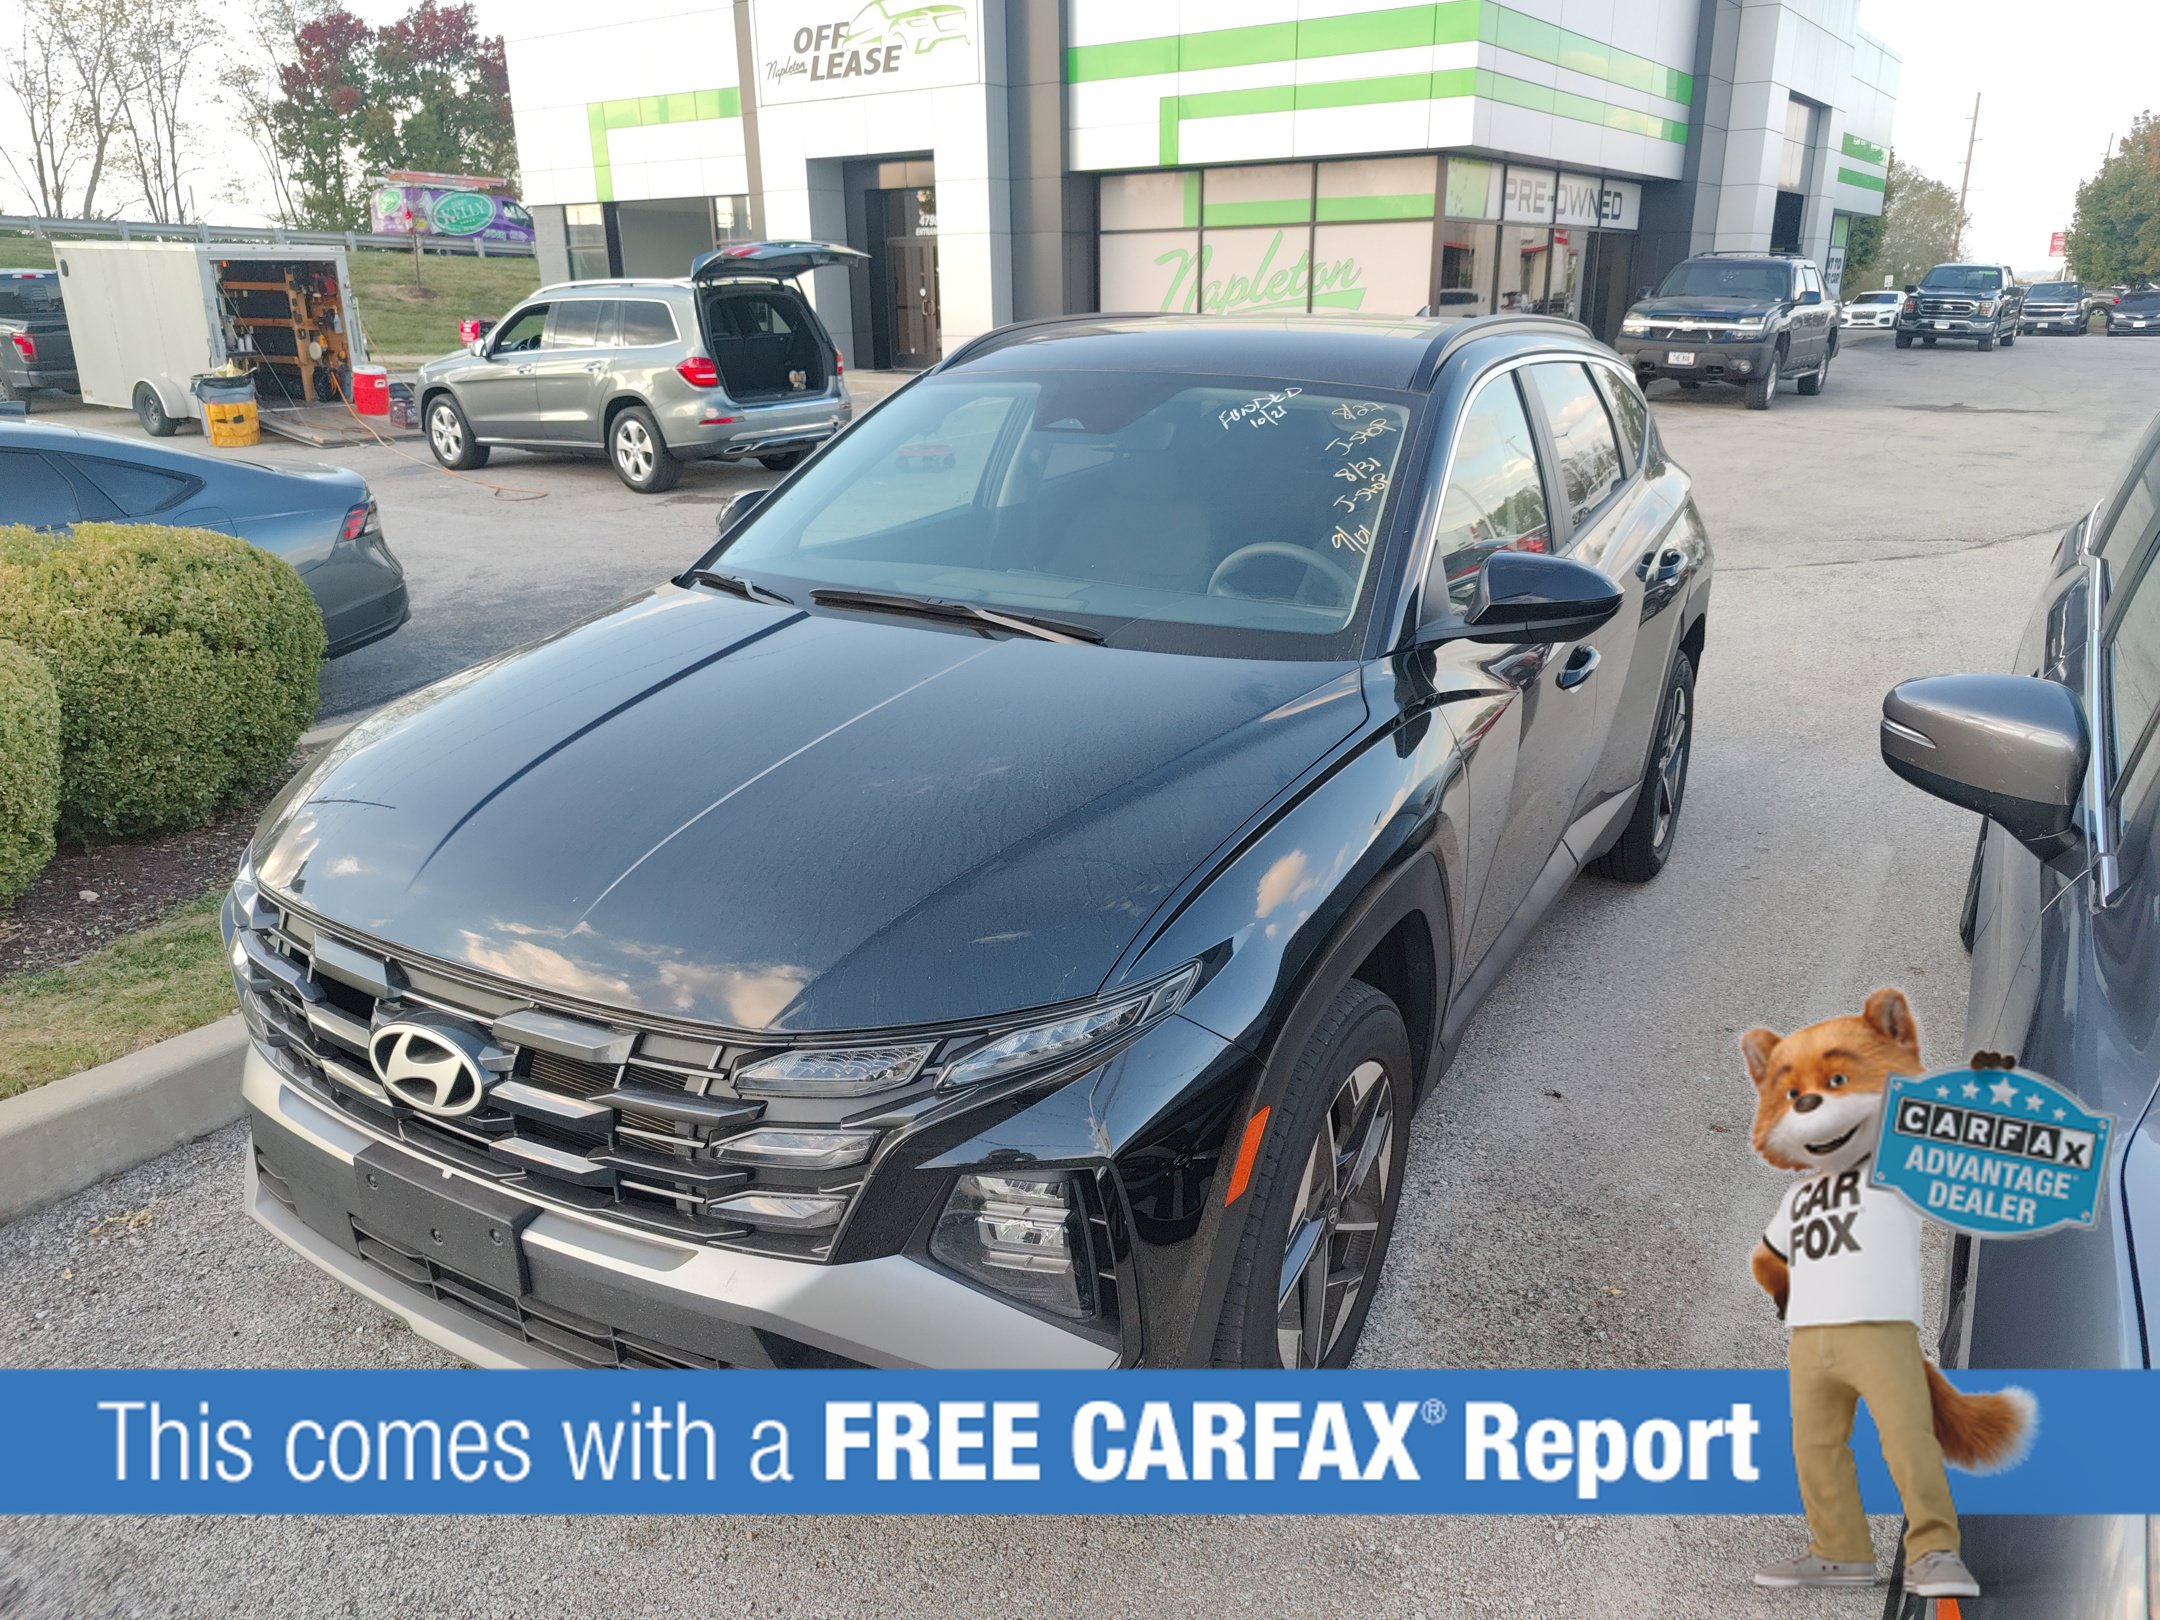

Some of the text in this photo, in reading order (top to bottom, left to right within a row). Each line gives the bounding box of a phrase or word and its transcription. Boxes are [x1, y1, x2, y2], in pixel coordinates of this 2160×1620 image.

[793, 21, 850, 54] OFF
[766, 56, 808, 85] Napleton
[810, 45, 903, 81] LEASE
[436, 201, 484, 225] KELLY
[1505, 178, 1623, 221] PRE-OWNED
[1153, 229, 1364, 316] Napleton
[1218, 387, 1303, 430] FUNDED
[1250, 405, 1288, 428] 10/21
[1333, 457, 1382, 482] 8/31
